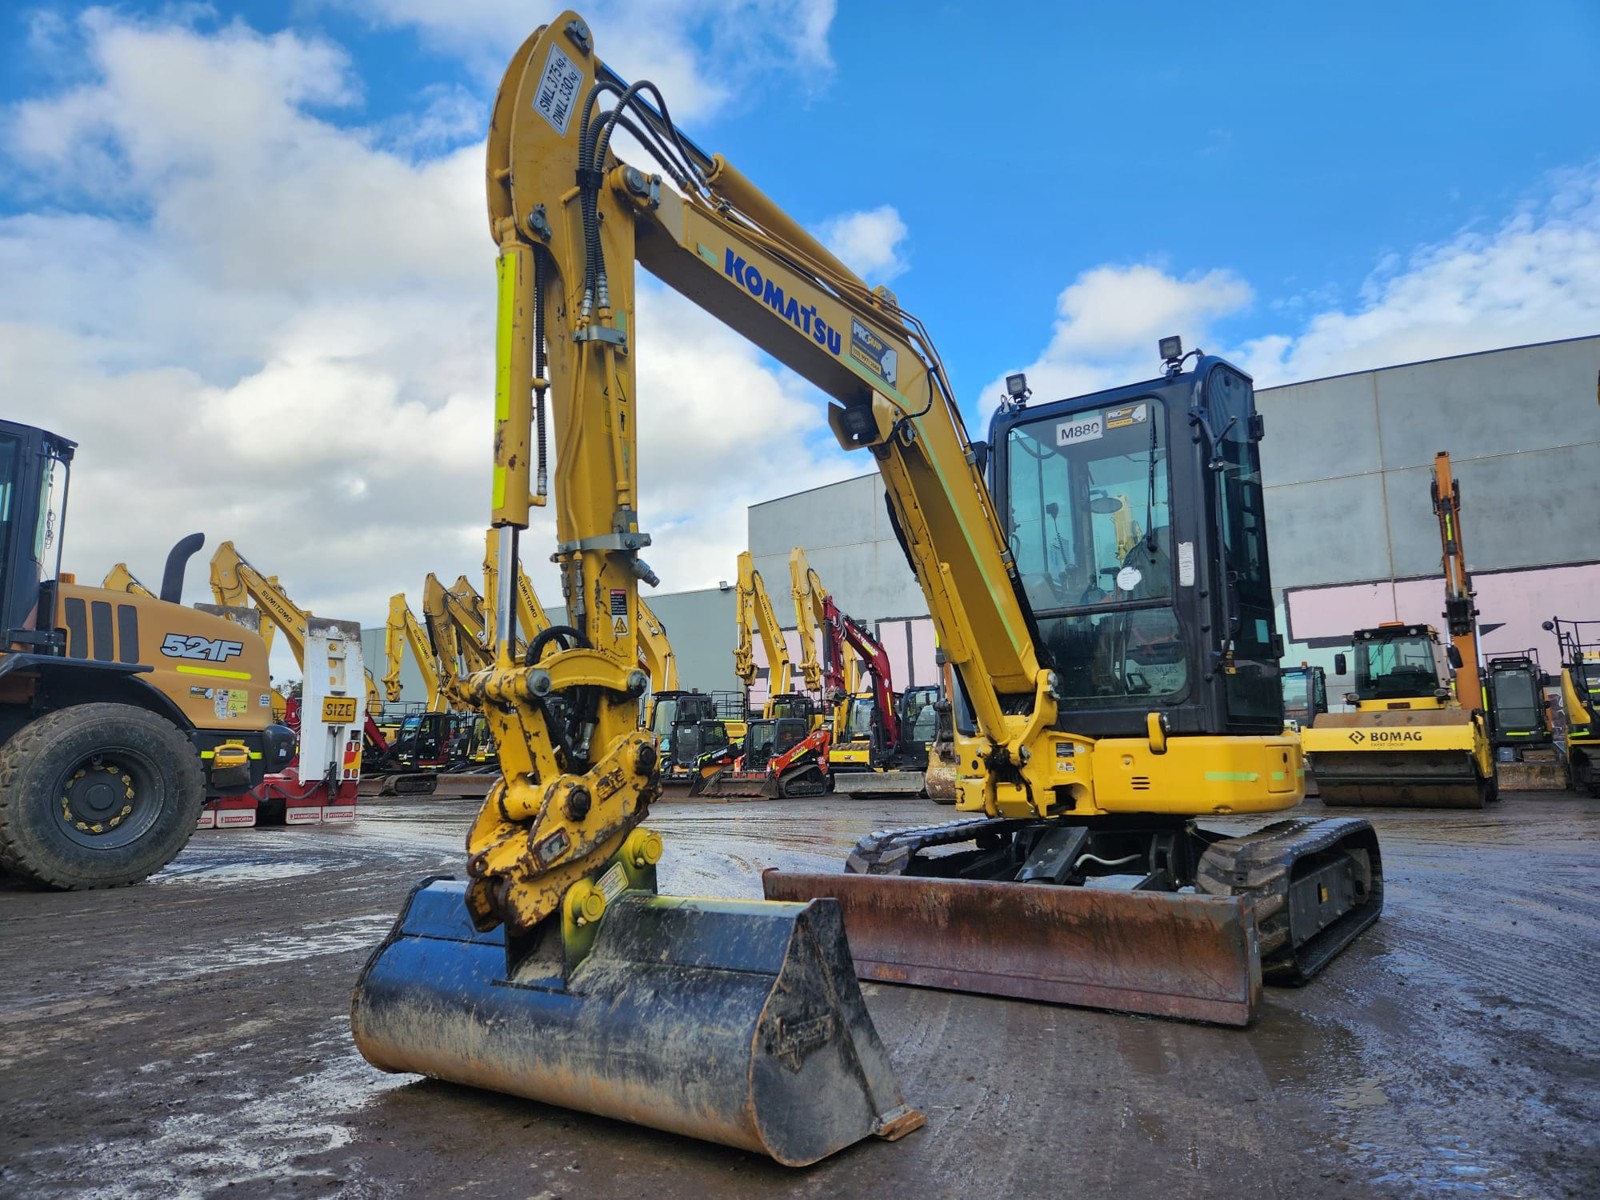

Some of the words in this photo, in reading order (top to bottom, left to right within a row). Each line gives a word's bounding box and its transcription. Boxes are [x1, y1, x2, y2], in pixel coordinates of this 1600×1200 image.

[724, 246, 842, 356] KOMATSU
[261, 589, 293, 623] SUMITOMO
[518, 575, 538, 619] SUMITOMO
[160, 632, 244, 663] 521F
[412, 629, 430, 660] SUMITOMO
[325, 703, 353, 717] SIZE
[1370, 731, 1422, 742] BOMAG
